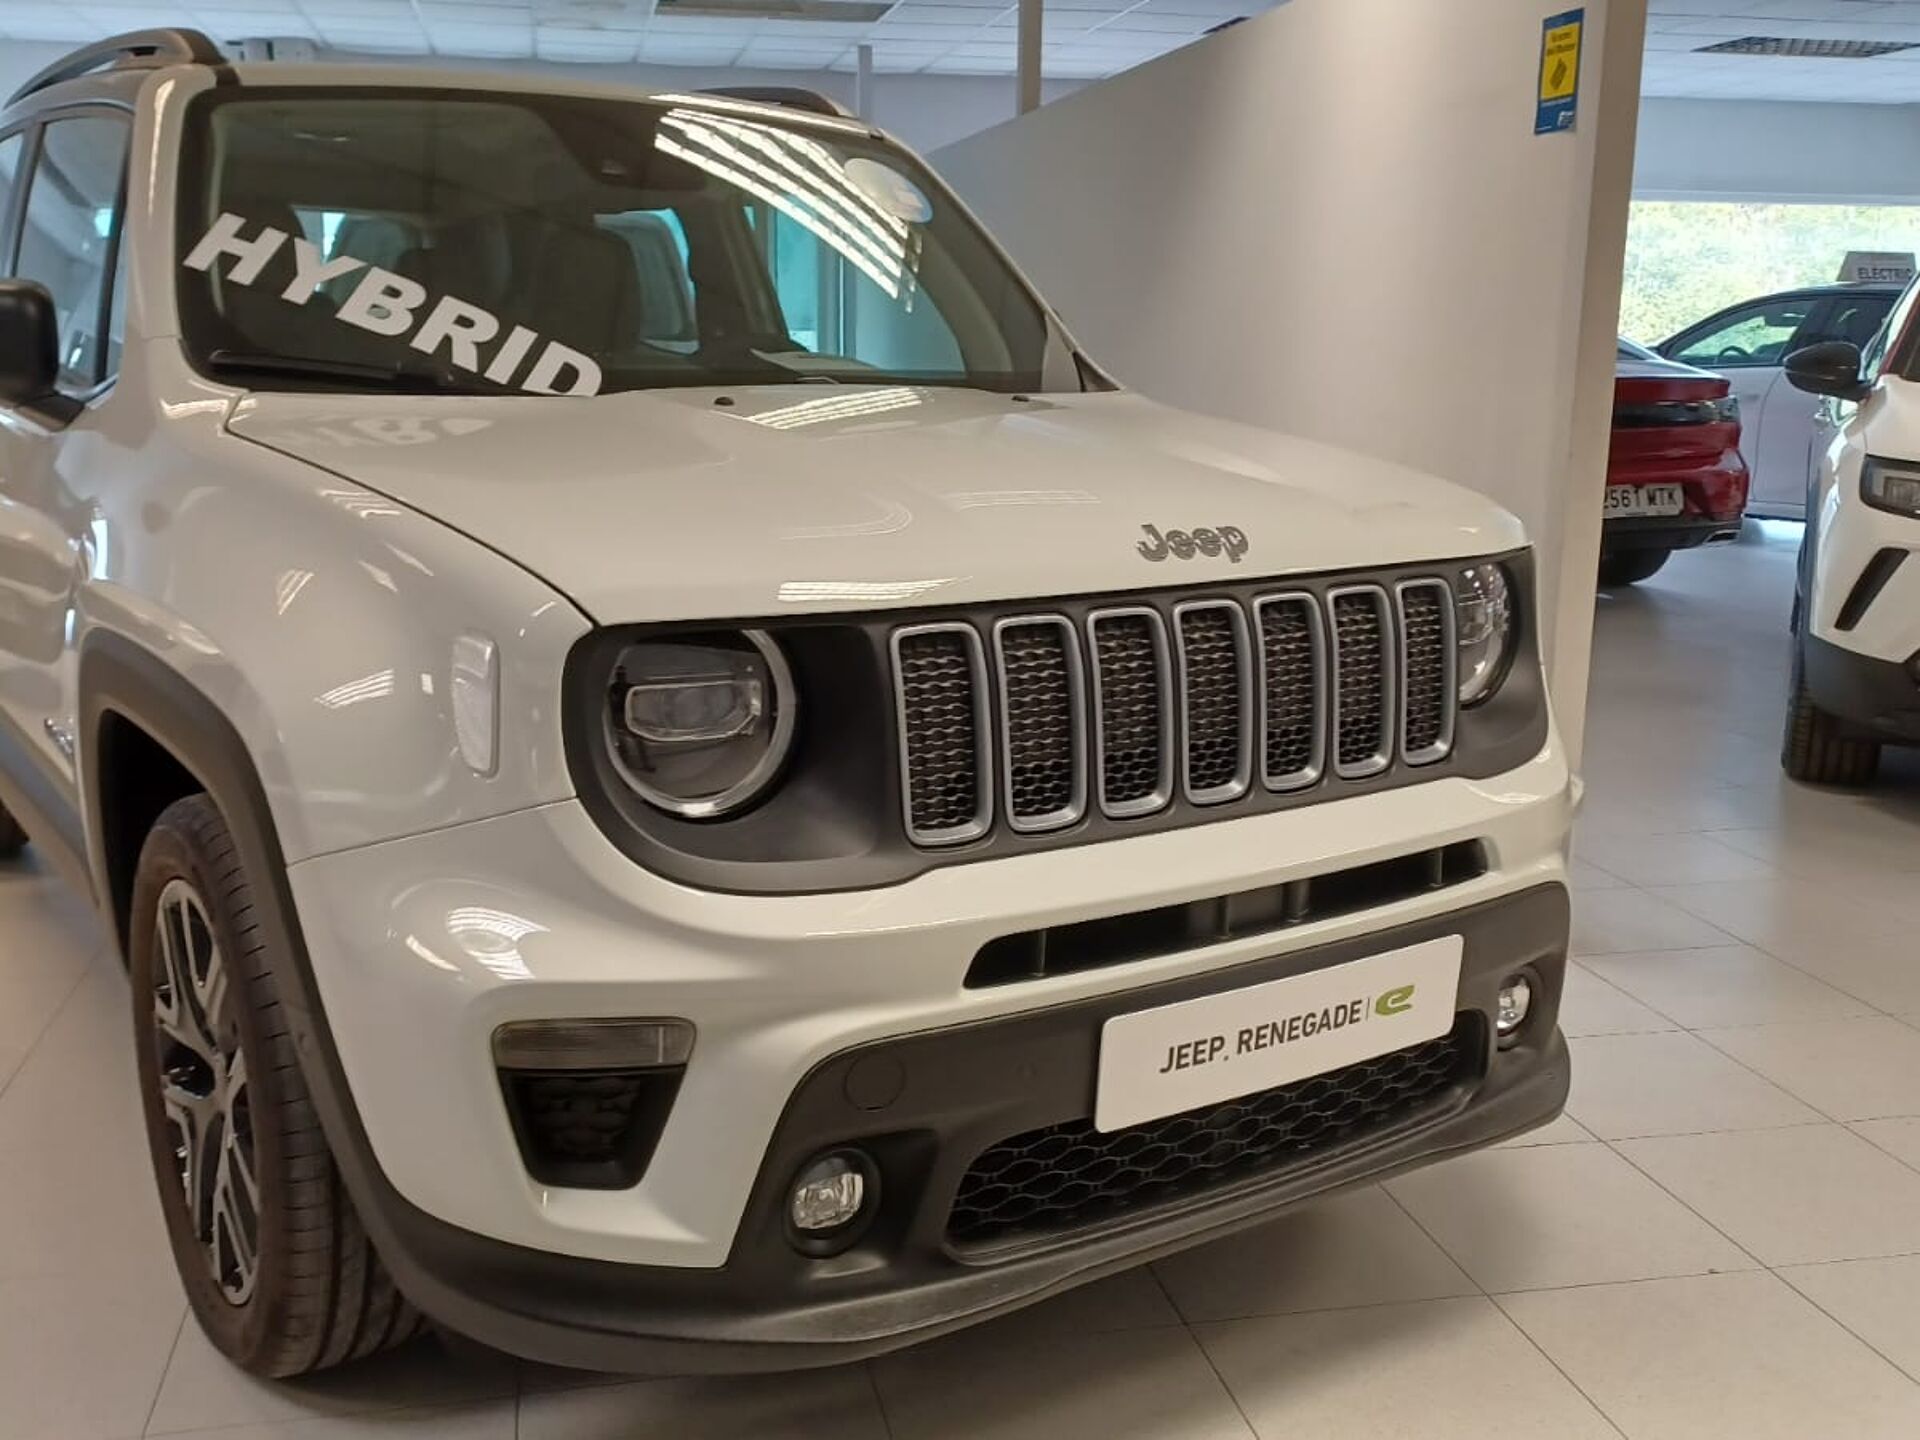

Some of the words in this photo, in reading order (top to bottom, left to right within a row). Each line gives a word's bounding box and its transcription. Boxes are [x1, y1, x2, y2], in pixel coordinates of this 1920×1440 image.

[183, 212, 602, 397] HYBRID
[1136, 524, 1249, 563] Jeep
[1236, 999, 1363, 1054] RENEGADE
